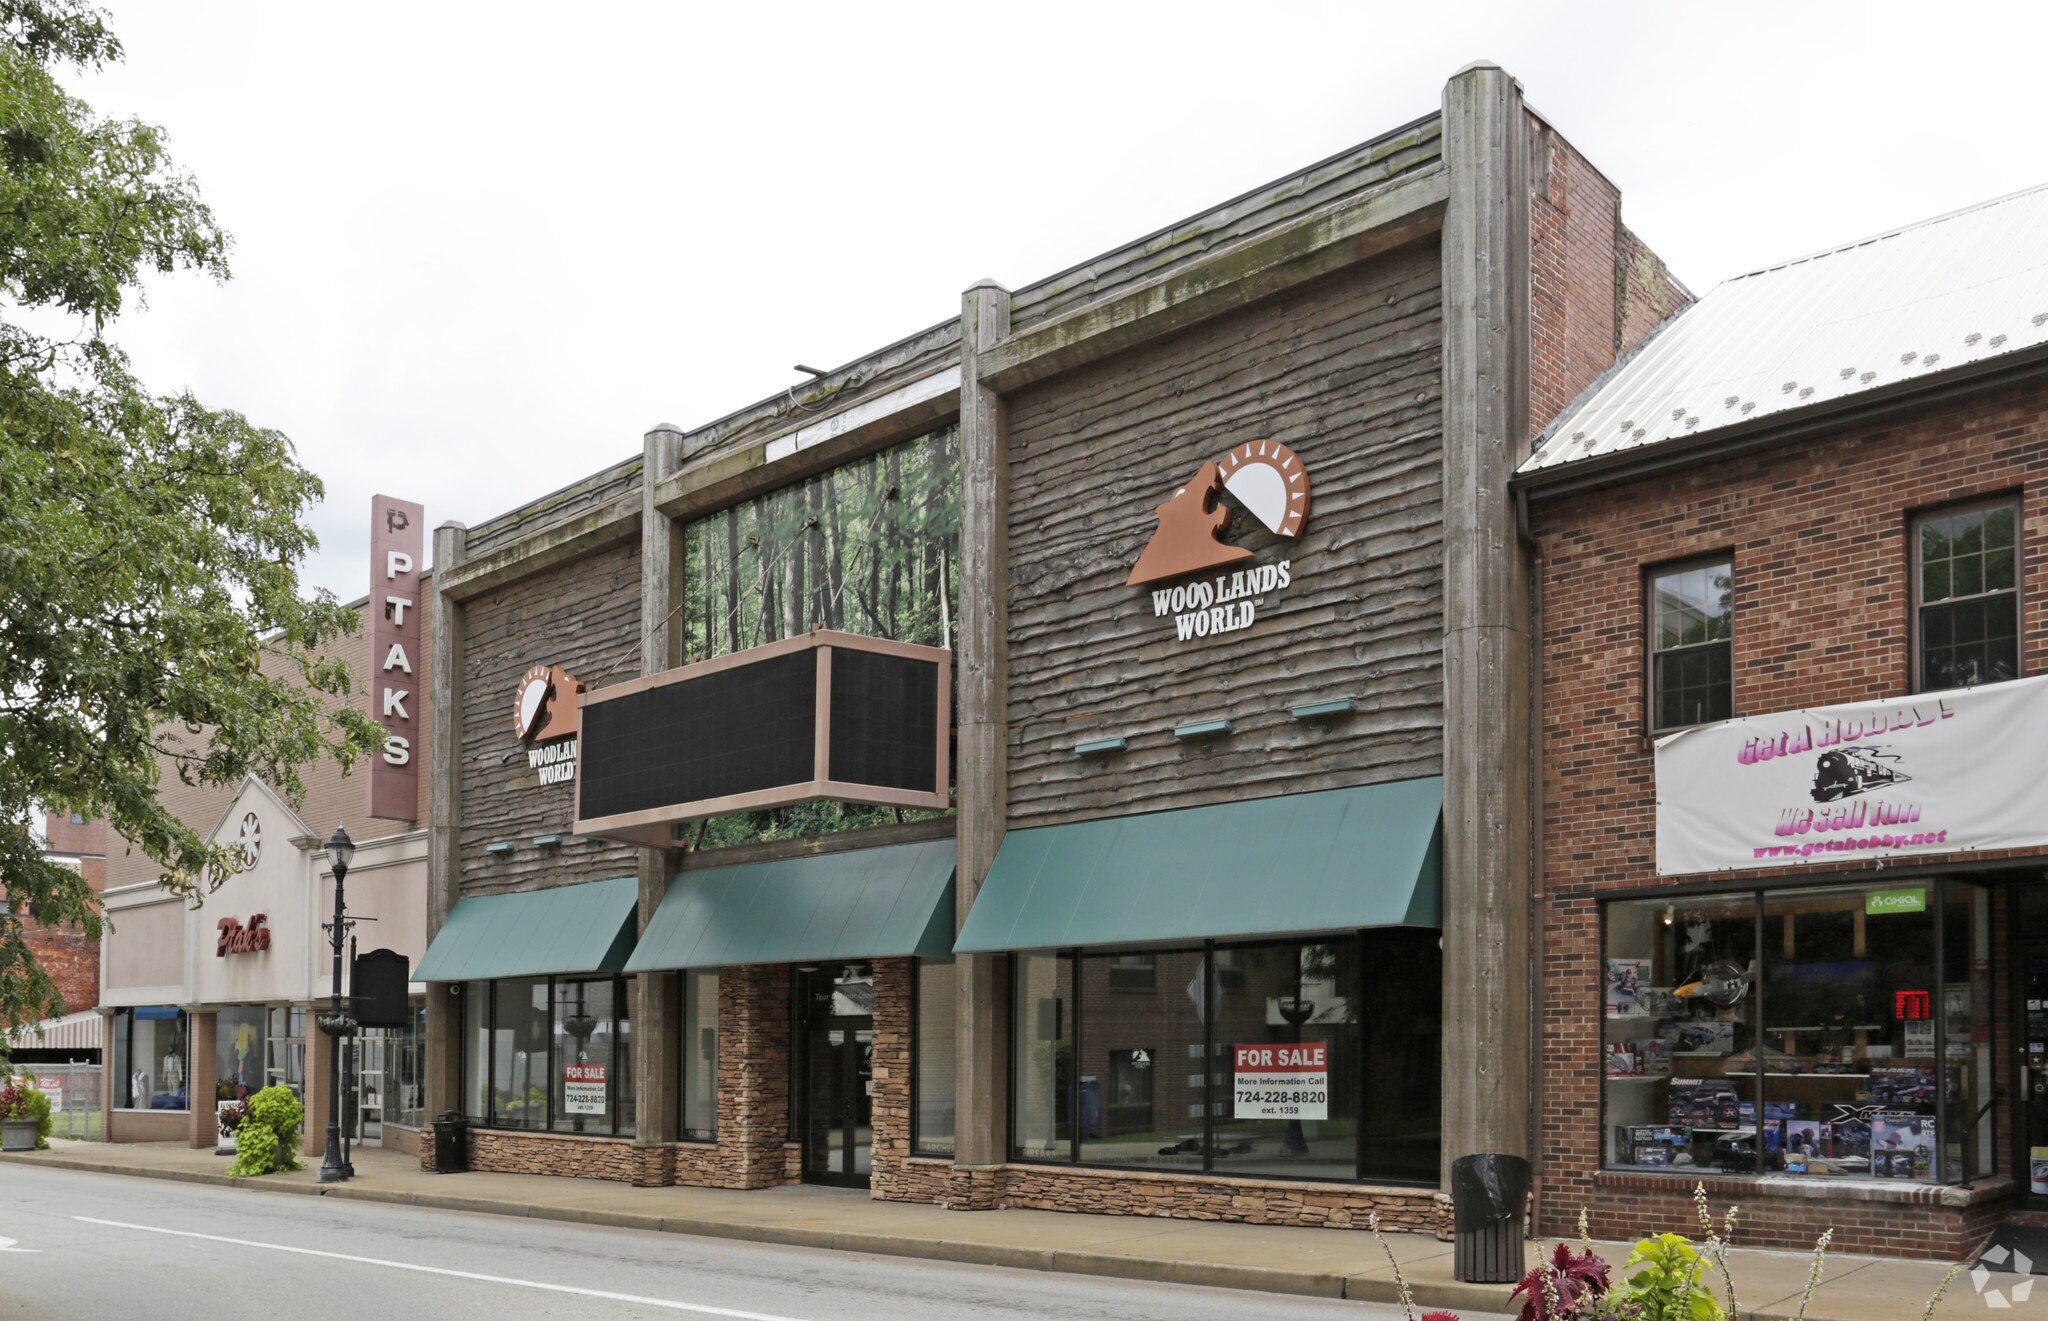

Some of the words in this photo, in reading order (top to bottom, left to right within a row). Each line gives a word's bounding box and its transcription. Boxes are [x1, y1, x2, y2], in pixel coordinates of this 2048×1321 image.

[1152, 559, 1291, 617] WOODLANDS
[1175, 600, 1255, 641] WORLD
[382, 550, 413, 765] PTAKS
[538, 761, 574, 786] WORLD
[1774, 807, 1814, 836] We
[1812, 799, 1868, 833] sell
[1753, 829, 1949, 859] www.getahobby.net
[1237, 1048, 1273, 1066] FOR
[1278, 1048, 1325, 1066] SALE
[566, 1067, 582, 1079] FOR
[584, 1067, 605, 1079] SALE
[1237, 1077, 1258, 1085] More
[1259, 1077, 1306, 1085] Information
[1308, 1077, 1325, 1085] Call
[1669, 1077, 1704, 1086] SUMMIT
[566, 1094, 605, 1104] 724-228-8820
[1236, 1091, 1326, 1104] 724-228-8820
[1279, 1106, 1299, 1114] 1359
[1920, 1119, 1936, 1128] RC
